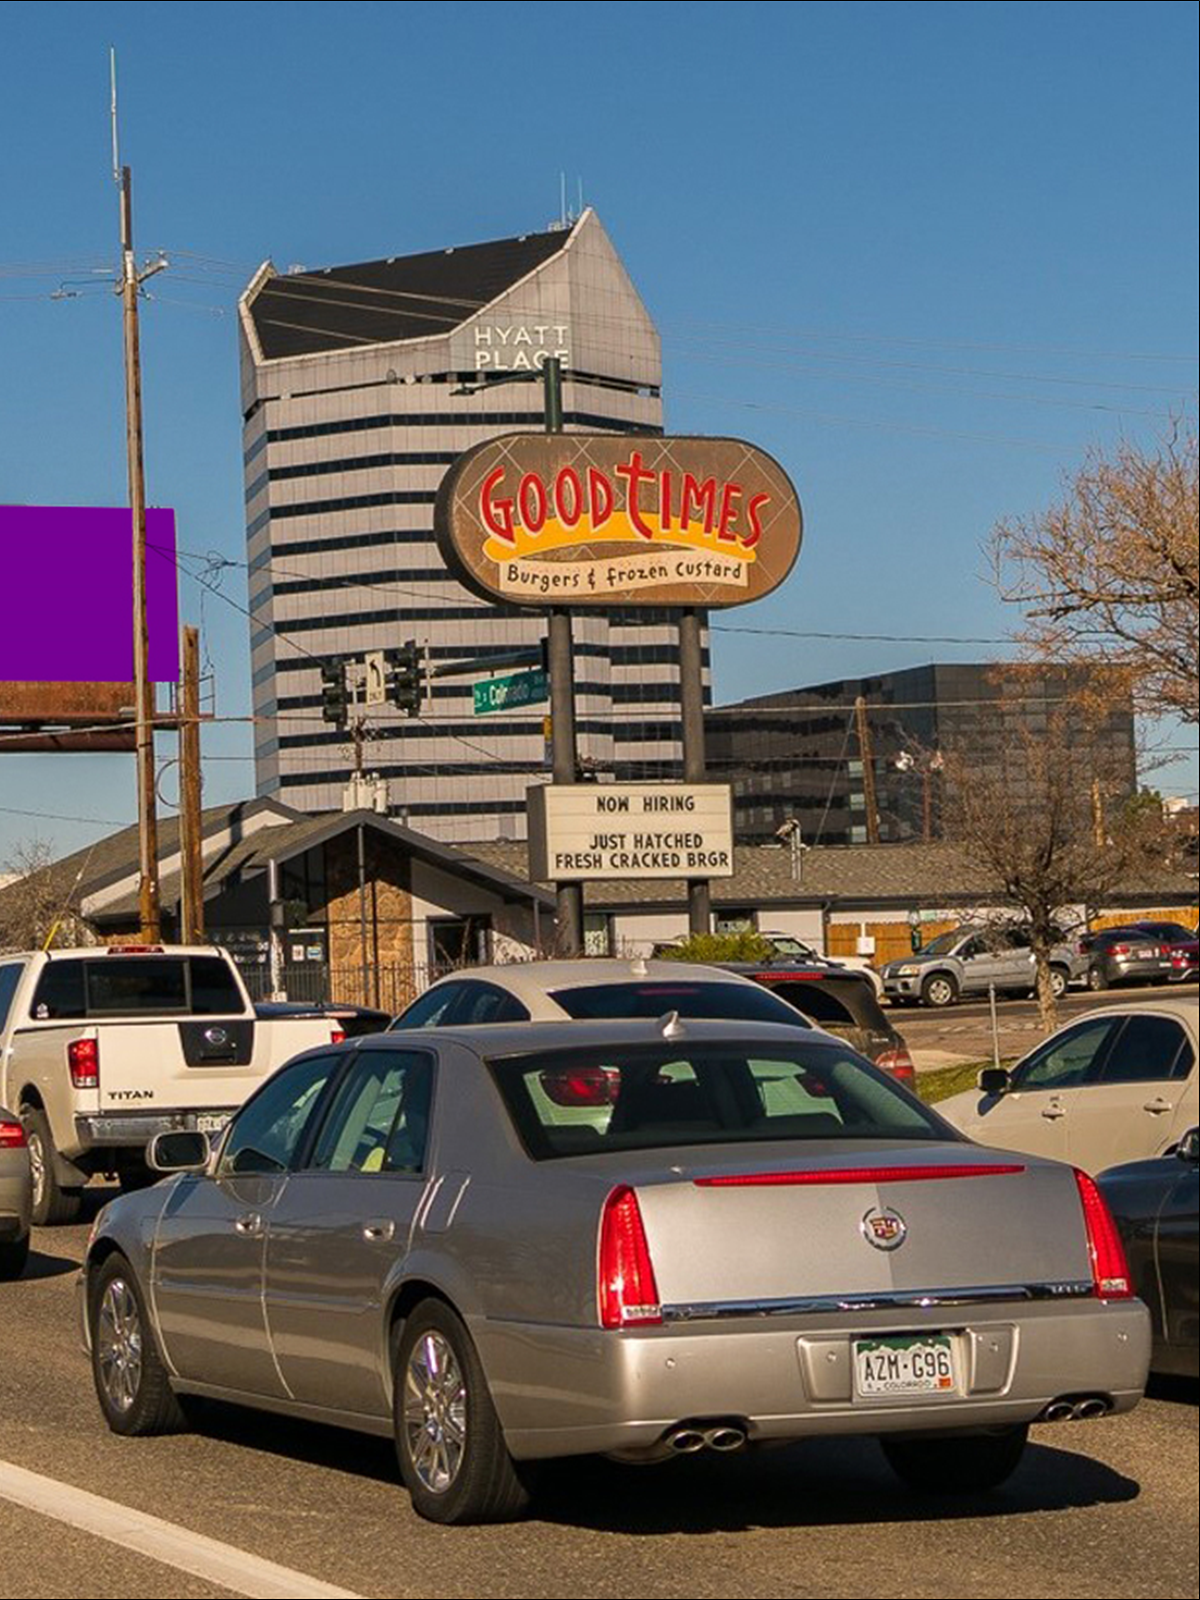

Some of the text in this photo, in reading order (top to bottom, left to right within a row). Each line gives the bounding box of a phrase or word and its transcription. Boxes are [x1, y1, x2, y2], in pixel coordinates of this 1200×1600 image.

[474, 326, 568, 345] HYATT
[475, 350, 569, 370] PLACE
[480, 465, 615, 547] GOOD
[507, 564, 580, 592] Burgers
[587, 569, 596, 590] &
[597, 795, 695, 812] NOW HIRING
[589, 833, 703, 850] JUST HATCHED
[556, 851, 729, 869] FRESH CRACKED BRGR
[108, 1090, 154, 1100] TITAN
